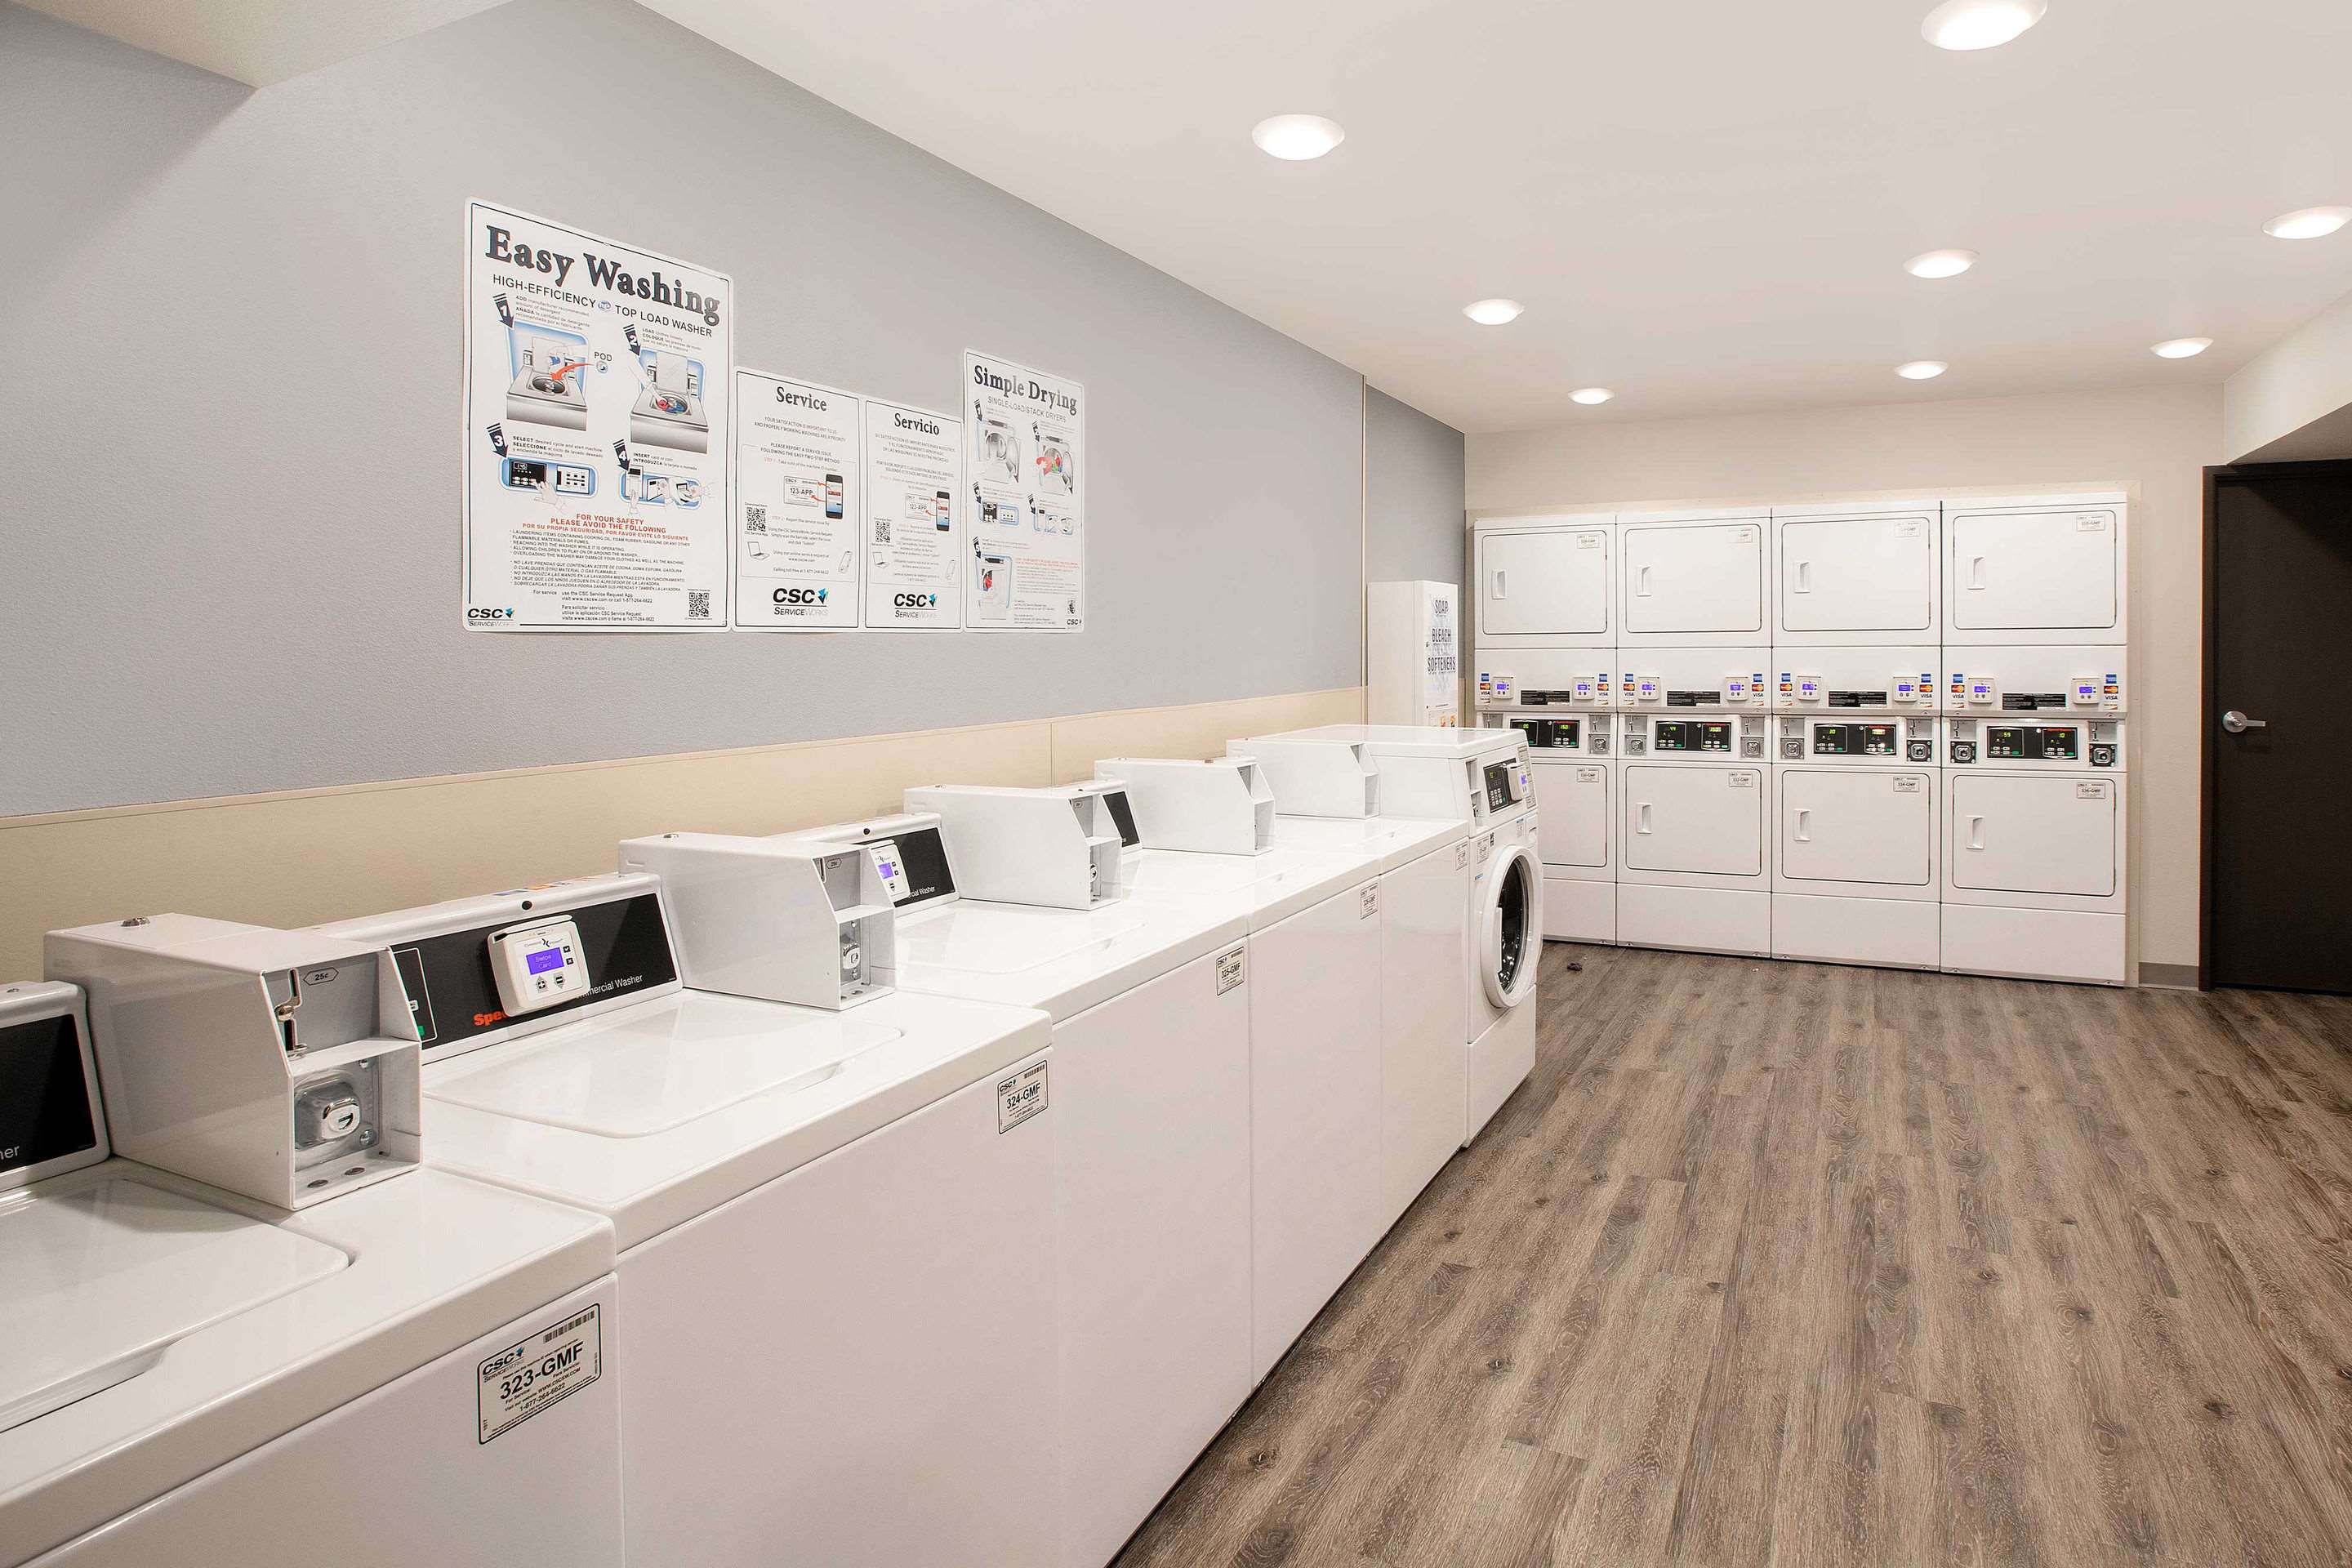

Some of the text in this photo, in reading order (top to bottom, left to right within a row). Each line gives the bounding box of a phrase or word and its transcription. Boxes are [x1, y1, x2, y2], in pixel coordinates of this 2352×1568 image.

[485, 224, 719, 328] Easy Washing
[492, 273, 595, 309] HIGH-EFFICIENCY
[615, 304, 636, 318] TOP
[640, 310, 669, 327] LOAD
[671, 318, 711, 337] WASHER
[594, 350, 612, 362] POD
[974, 364, 1077, 416] Simple Drying
[776, 386, 827, 412] Service
[894, 412, 939, 435] Servicio
[1045, 411, 1067, 423] DRYERS
[493, 434, 503, 448] 3
[512, 441, 546, 450] SELECCIONE
[618, 449, 626, 461] 4
[790, 488, 813, 496] 123-APP
[550, 518, 581, 526] PLEASE
[582, 520, 606, 528] AVOID
[625, 524, 666, 533] FOLLOWING
[594, 514, 614, 523] YOUR
[616, 516, 644, 525] SAFETY
[773, 588, 815, 604] CSC
[894, 593, 927, 608] CSC
[468, 608, 504, 619] CSC
[1434, 599, 1449, 614] SOAP
[1432, 628, 1451, 643] BLEACH
[1428, 657, 1456, 672] SOFTENERS
[615, 974, 643, 988] Washer
[474, 1010, 506, 1026] Spe
[1000, 1081, 1012, 1092] CSC
[1007, 1082, 1040, 1109] 324-GMF
[483, 1352, 514, 1375] CSC
[500, 1341, 583, 1400] 323-GMF
